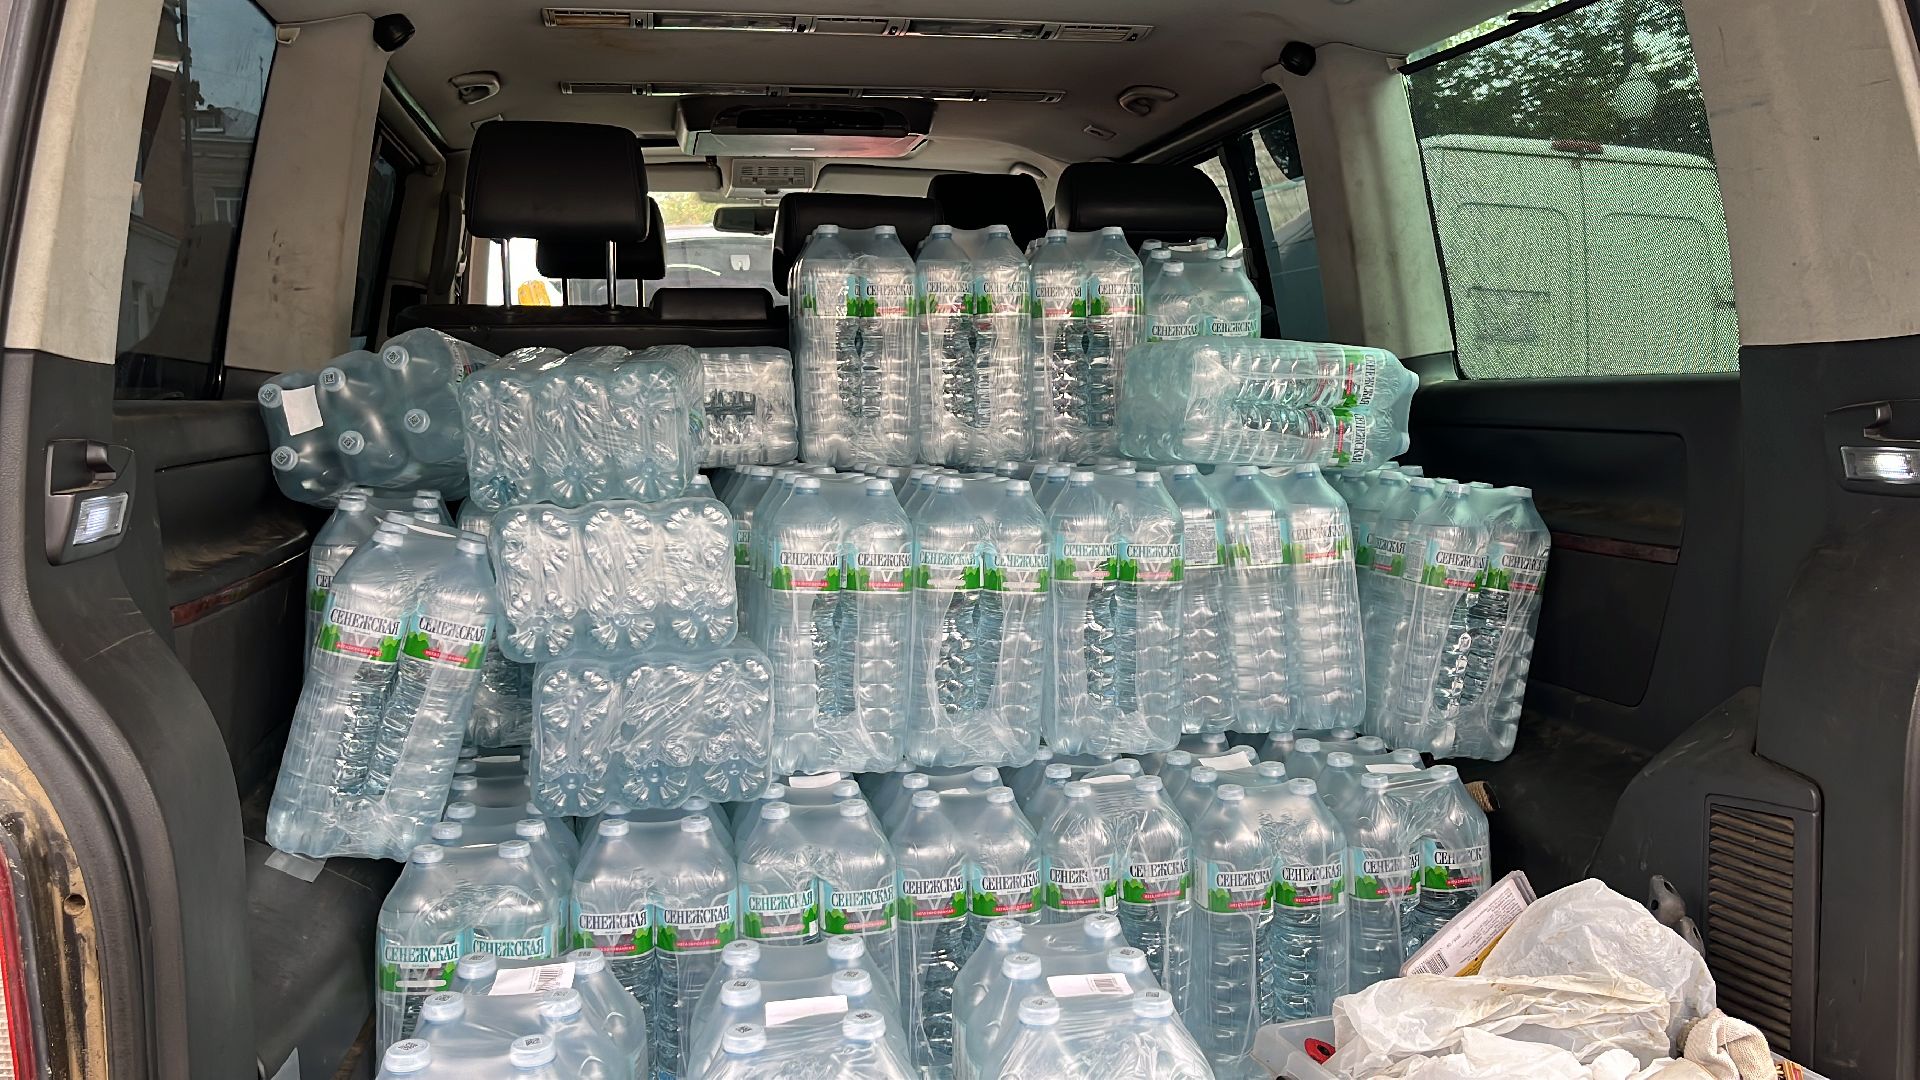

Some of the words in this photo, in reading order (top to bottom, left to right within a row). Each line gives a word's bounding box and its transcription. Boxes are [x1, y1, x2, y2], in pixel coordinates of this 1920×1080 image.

[780, 552, 838, 566] СЕНЕЖСКАЯ
[857, 551, 911, 567] СЕНЕЖСКАЯ
[330, 607, 401, 636] СЕНЕЖСКАЯ
[419, 617, 487, 642] СЕНЕЖСКАЯ
[982, 871, 1040, 891] СЕНЕЖСКАЯ
[1282, 863, 1342, 881] СЕНЕЖСКАЯ
[903, 876, 963, 894] СЕНЕЖСКАЯ
[748, 889, 813, 911] СЕНЕЖСКАЯ
[832, 885, 894, 907] СЕНЕЖСКАЯ
[579, 911, 647, 930] СЕНЕЖСКАЯ
[664, 904, 730, 924] СЕНЕЖСКАЯ
[385, 943, 459, 964] СЕНЕЖСКАЯ
[473, 937, 545, 957] СЕНЕЖСКАЯ
